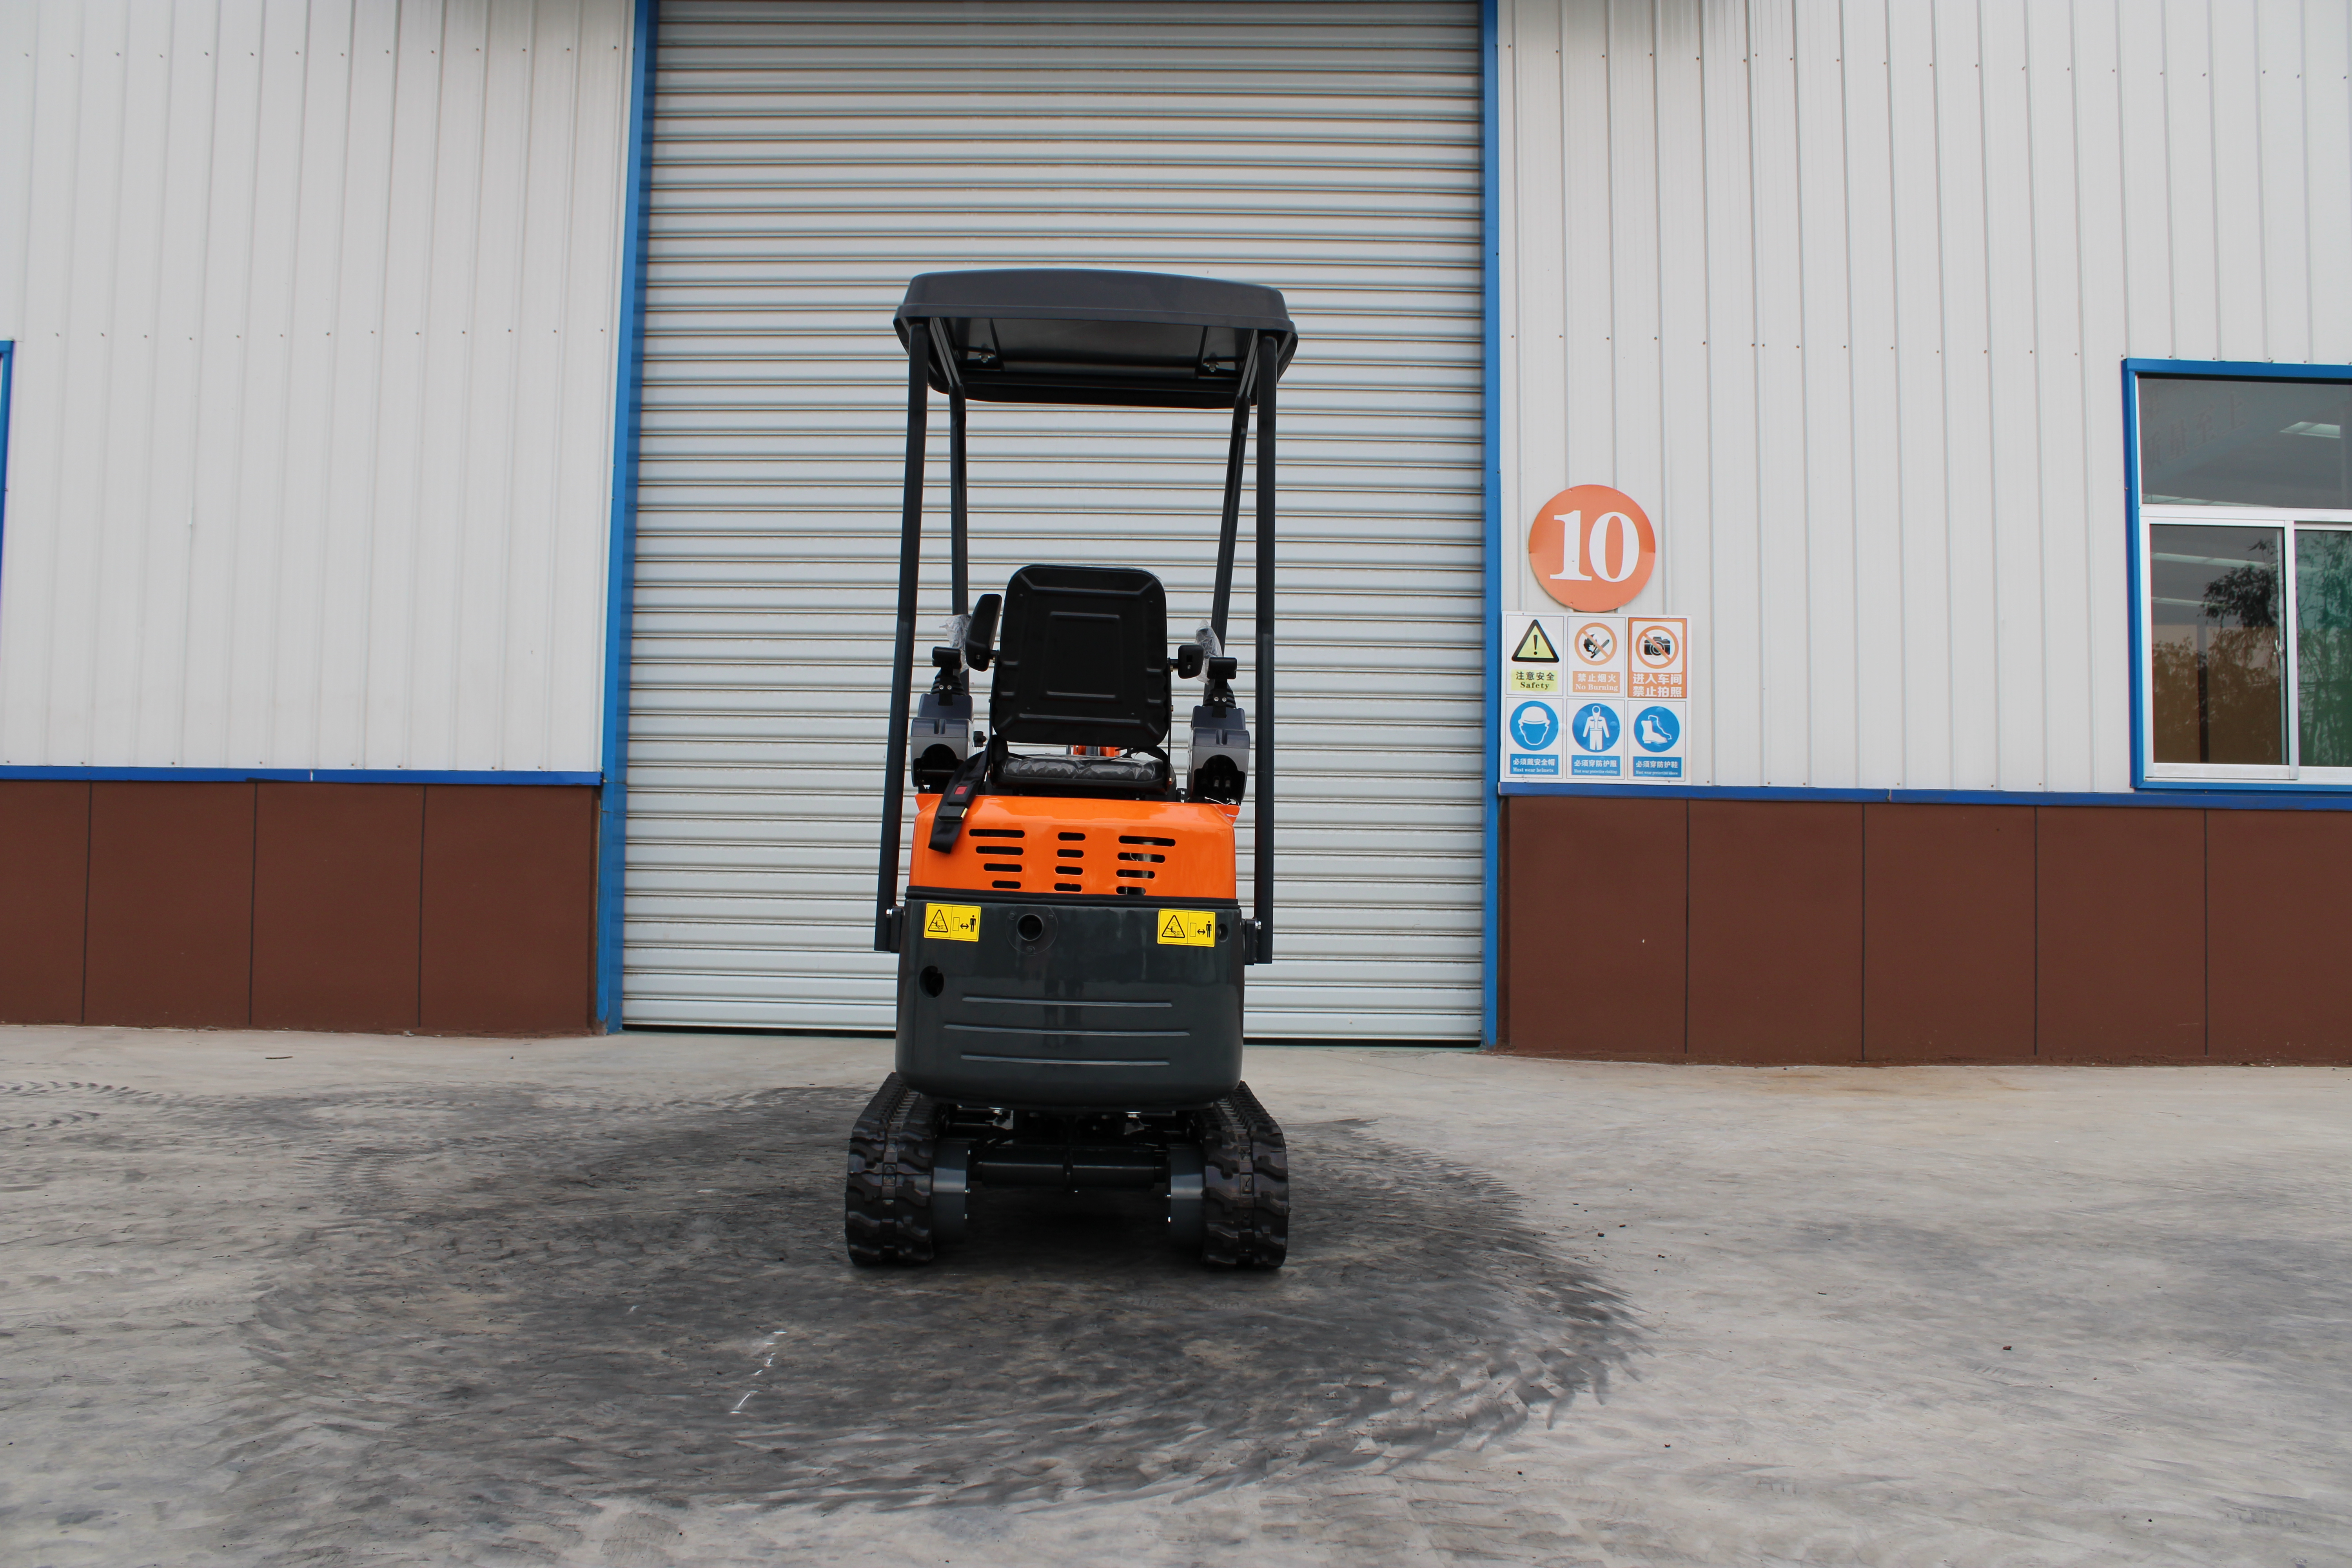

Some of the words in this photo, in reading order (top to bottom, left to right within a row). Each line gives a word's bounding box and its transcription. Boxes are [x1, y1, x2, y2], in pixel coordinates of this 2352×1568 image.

[1550, 510, 1639, 582] 10
[1516, 671, 1554, 681] 注意安全
[1578, 673, 1616, 682] 禁止烟火
[1633, 673, 1682, 684] 进入车间
[1633, 686, 1682, 697] 禁止拍照
